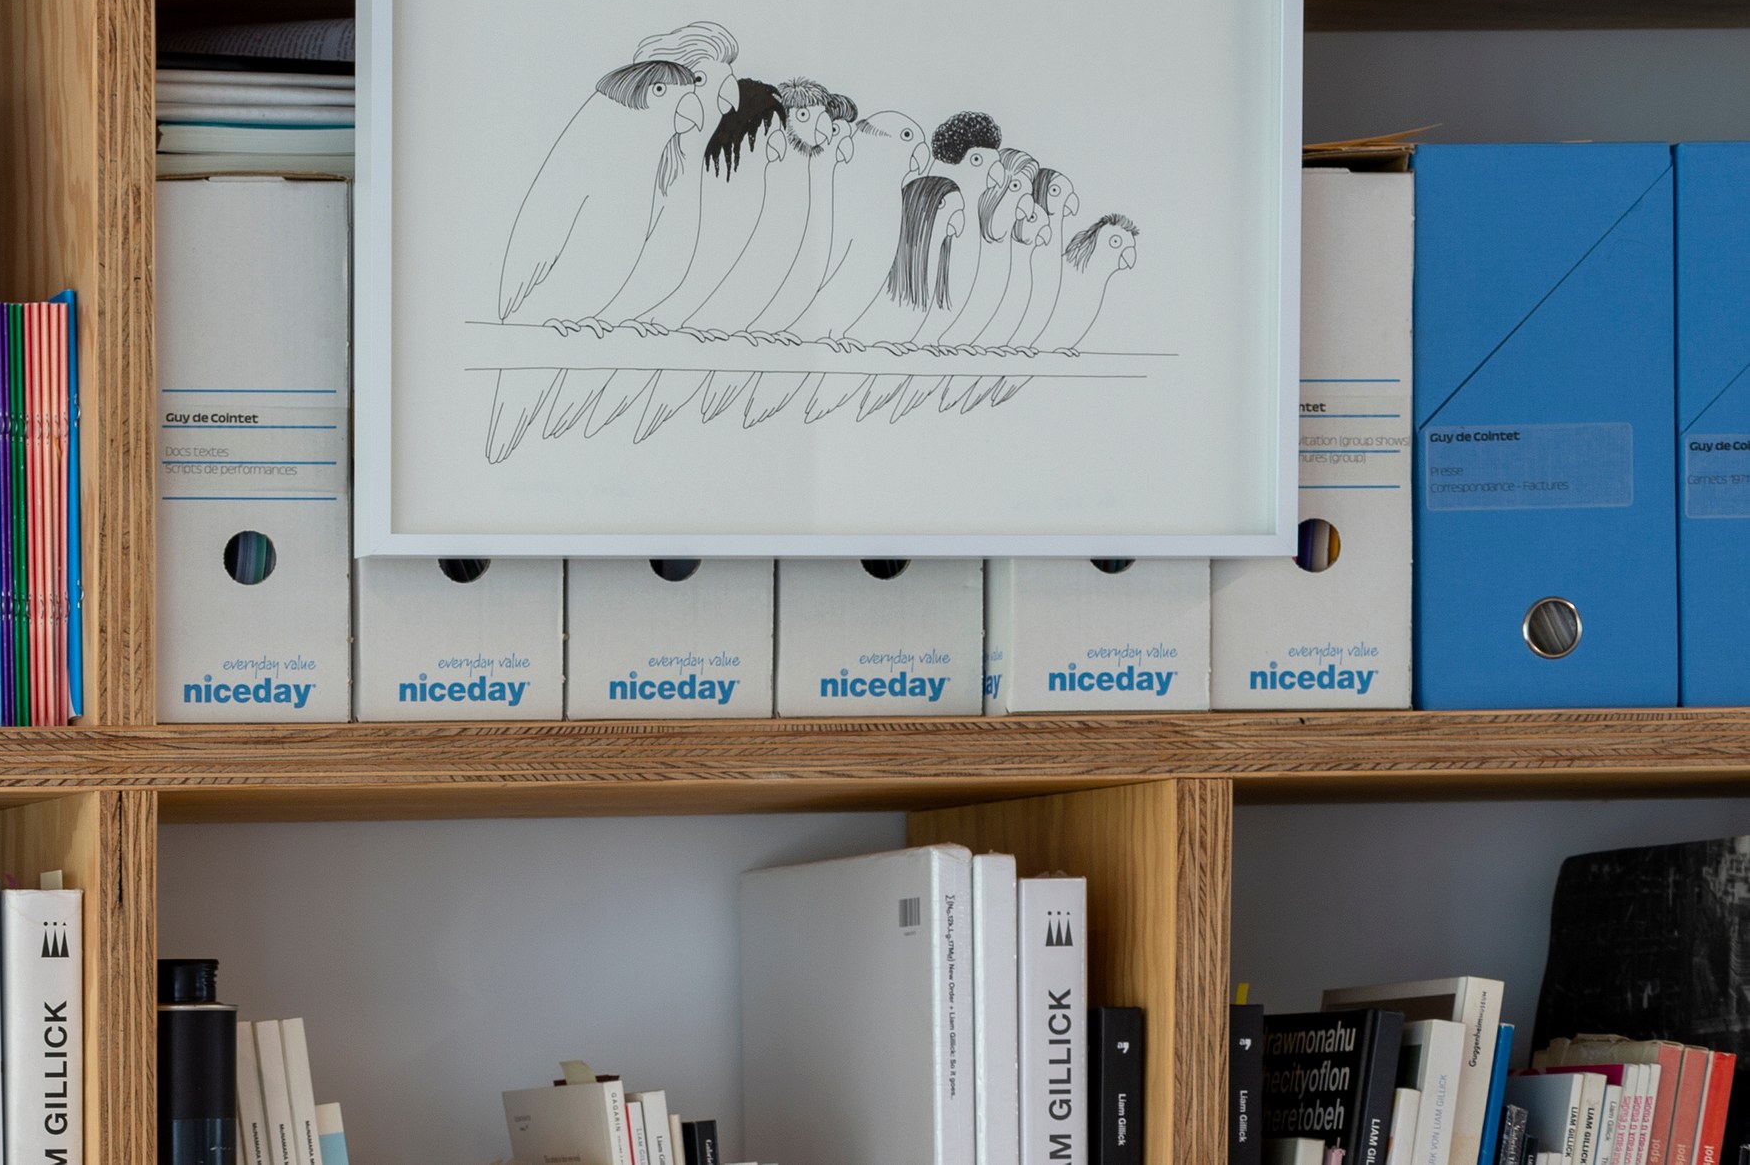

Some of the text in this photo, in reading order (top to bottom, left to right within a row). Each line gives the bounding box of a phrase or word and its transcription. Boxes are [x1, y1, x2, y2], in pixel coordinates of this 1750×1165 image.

[165, 412, 259, 424] Guy de Cointet
[165, 446, 229, 457] Docs textes
[1429, 430, 1520, 444] Guy de Cointet
[220, 463, 298, 476] performances
[222, 654, 317, 679] everyday value
[648, 650, 741, 675] everyday value
[1048, 662, 1174, 696] niceday
[1249, 661, 1377, 695] niceday
[183, 674, 312, 708] niceday
[399, 672, 526, 706] niceday
[609, 670, 736, 705] niceday
[820, 668, 947, 702] niceday
[44, 1000, 69, 1136] GILLICK
[1047, 988, 1072, 1122] GILLICK
[610, 1092, 621, 1132] GAGARIN
[1117, 1093, 1126, 1146] Liam Gillick
[1586, 1107, 1596, 1129] LIAM
